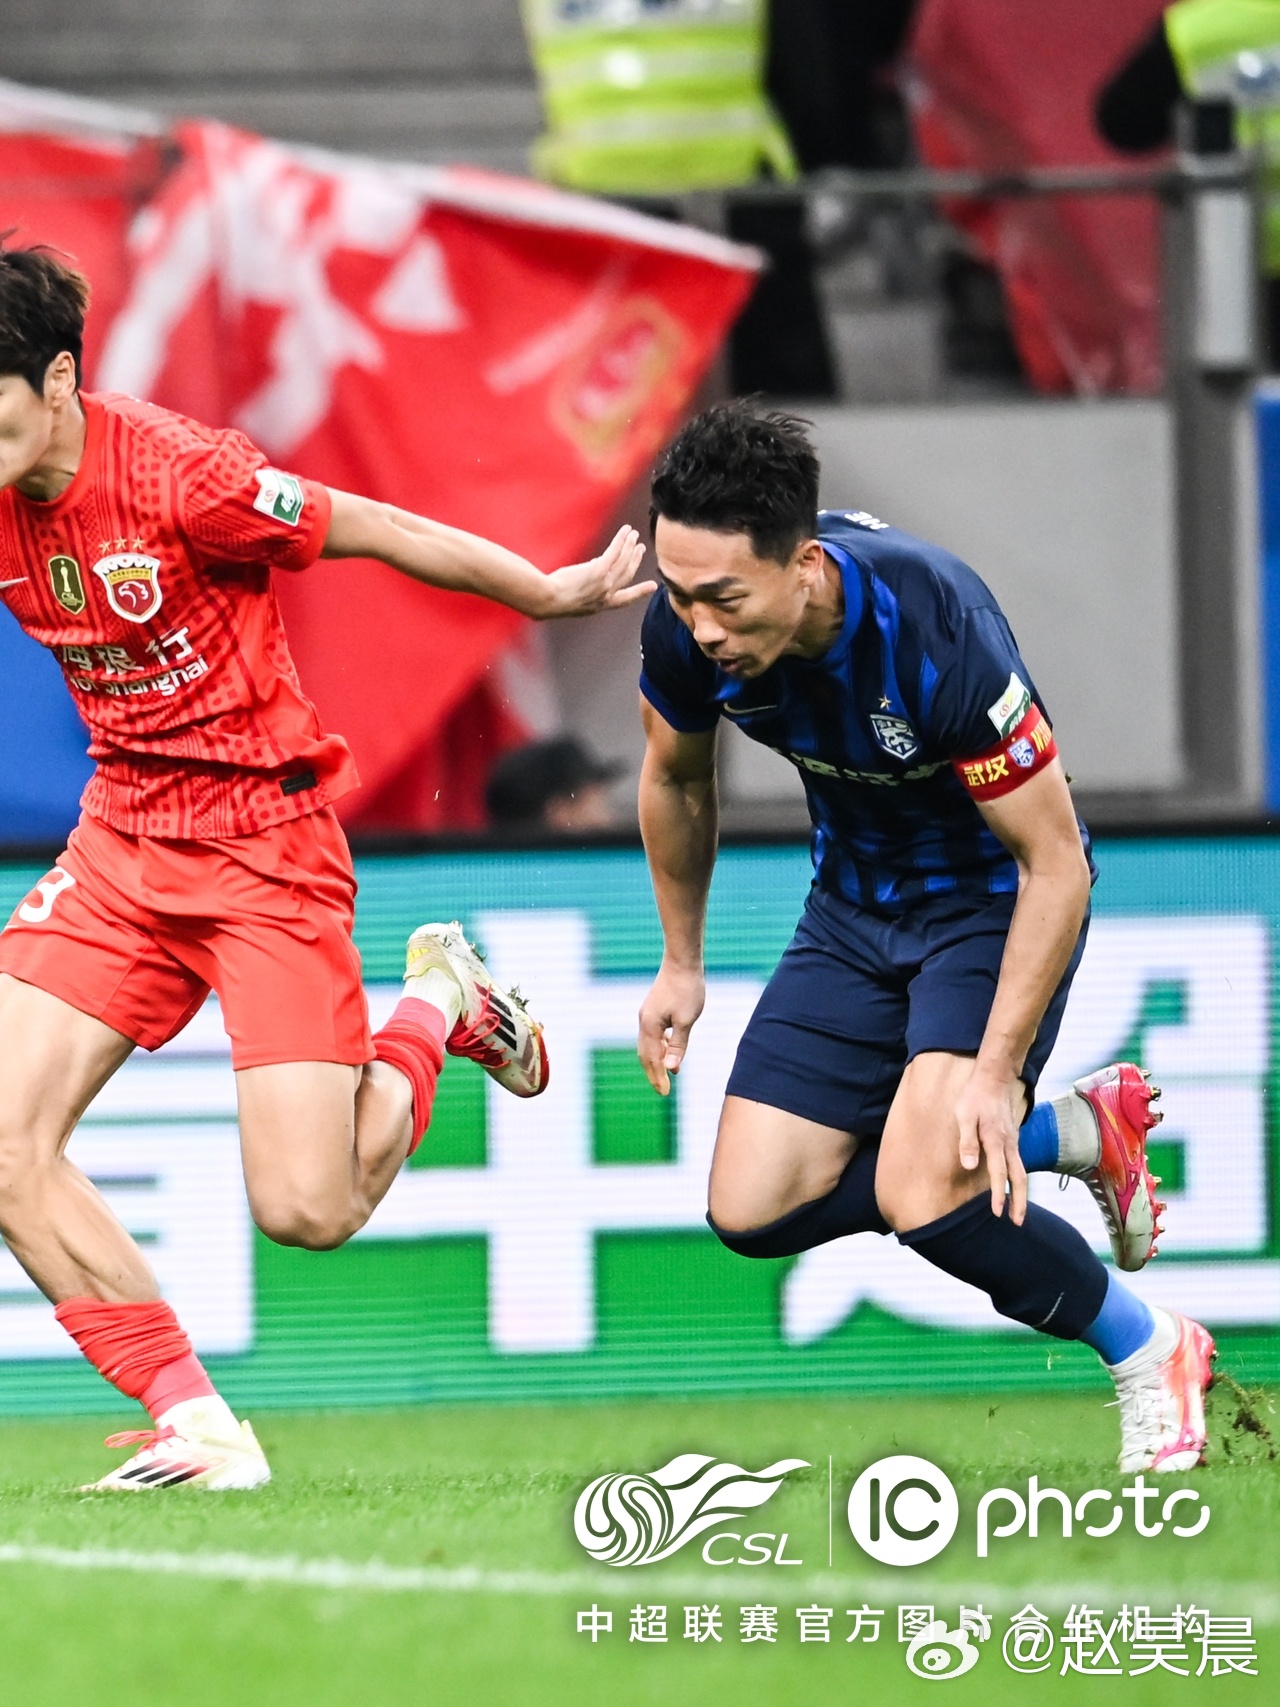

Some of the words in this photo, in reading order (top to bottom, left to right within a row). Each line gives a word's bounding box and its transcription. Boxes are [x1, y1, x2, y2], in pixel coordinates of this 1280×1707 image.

[100, 653, 209, 697] Shanghai
[963, 754, 1010, 787] 武汉
[18, 865, 77, 923] 3
